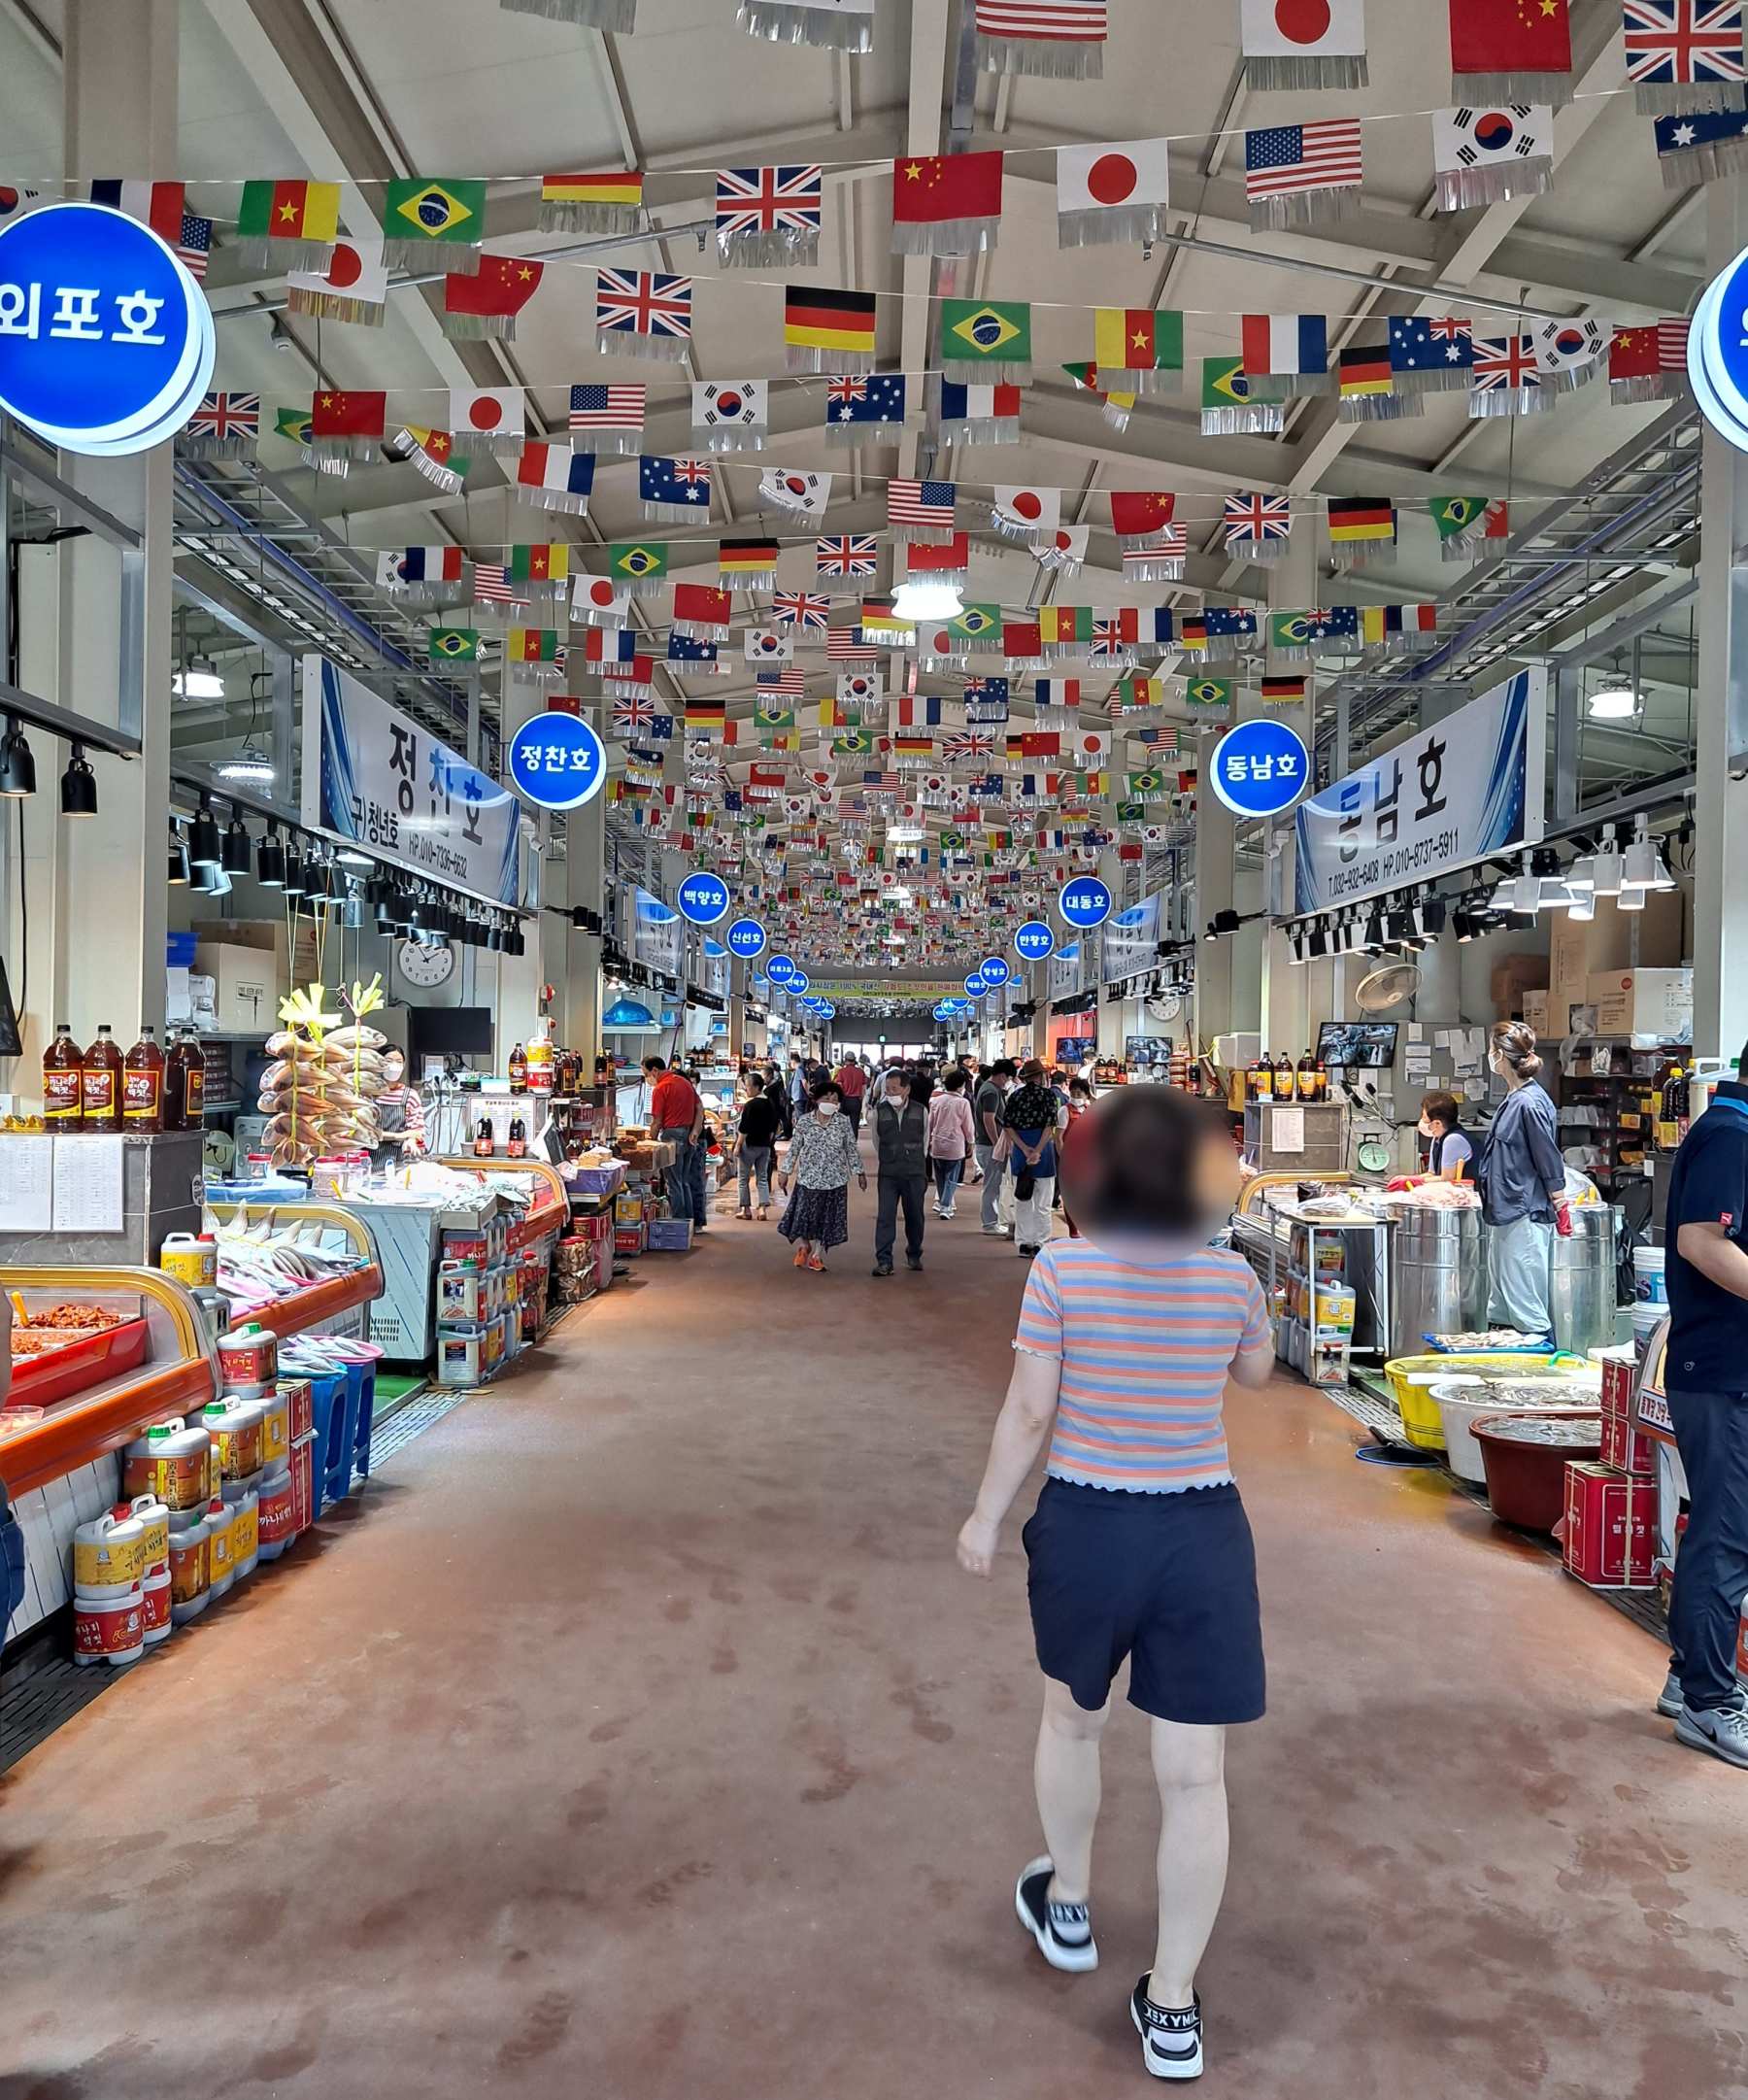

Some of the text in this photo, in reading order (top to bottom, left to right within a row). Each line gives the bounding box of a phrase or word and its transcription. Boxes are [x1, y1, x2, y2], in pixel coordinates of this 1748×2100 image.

[0, 283, 166, 345] 외포호
[521, 745, 591, 773] 정찬호
[1226, 754, 1298, 782] 동남호
[1337, 735, 1447, 864] 동남호
[684, 890, 723, 905] 백양호
[1065, 895, 1106, 909] 대동호
[732, 932, 761, 944] 신선호
